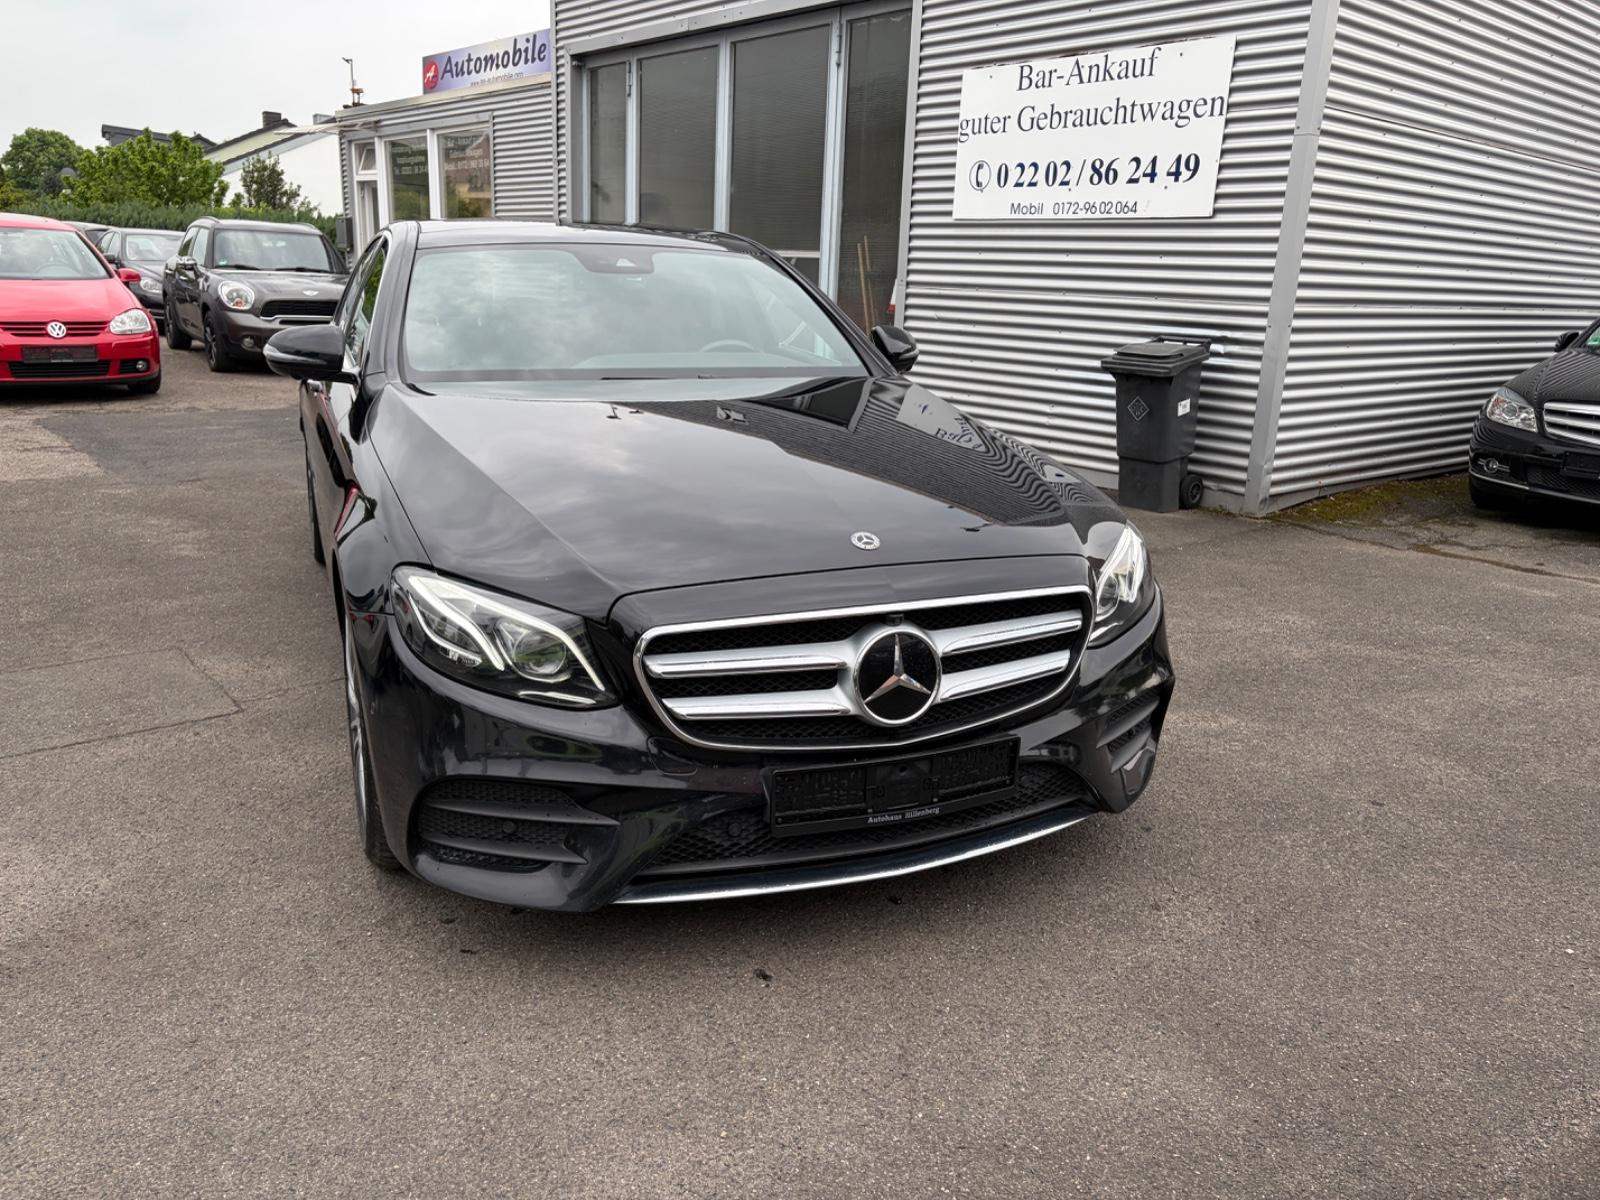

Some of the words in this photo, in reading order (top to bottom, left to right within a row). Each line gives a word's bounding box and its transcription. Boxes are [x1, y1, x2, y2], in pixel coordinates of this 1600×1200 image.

[440, 34, 547, 80] Automobile
[1016, 47, 1162, 91] Bar-Ankauf
[958, 113, 1012, 143] guter
[1017, 95, 1226, 132] Gebrauchtwagen
[1126, 155, 1158, 185] 24
[1166, 152, 1201, 183] 49
[1009, 202, 1044, 215] Mobil
[867, 814, 902, 824] Autohaus
